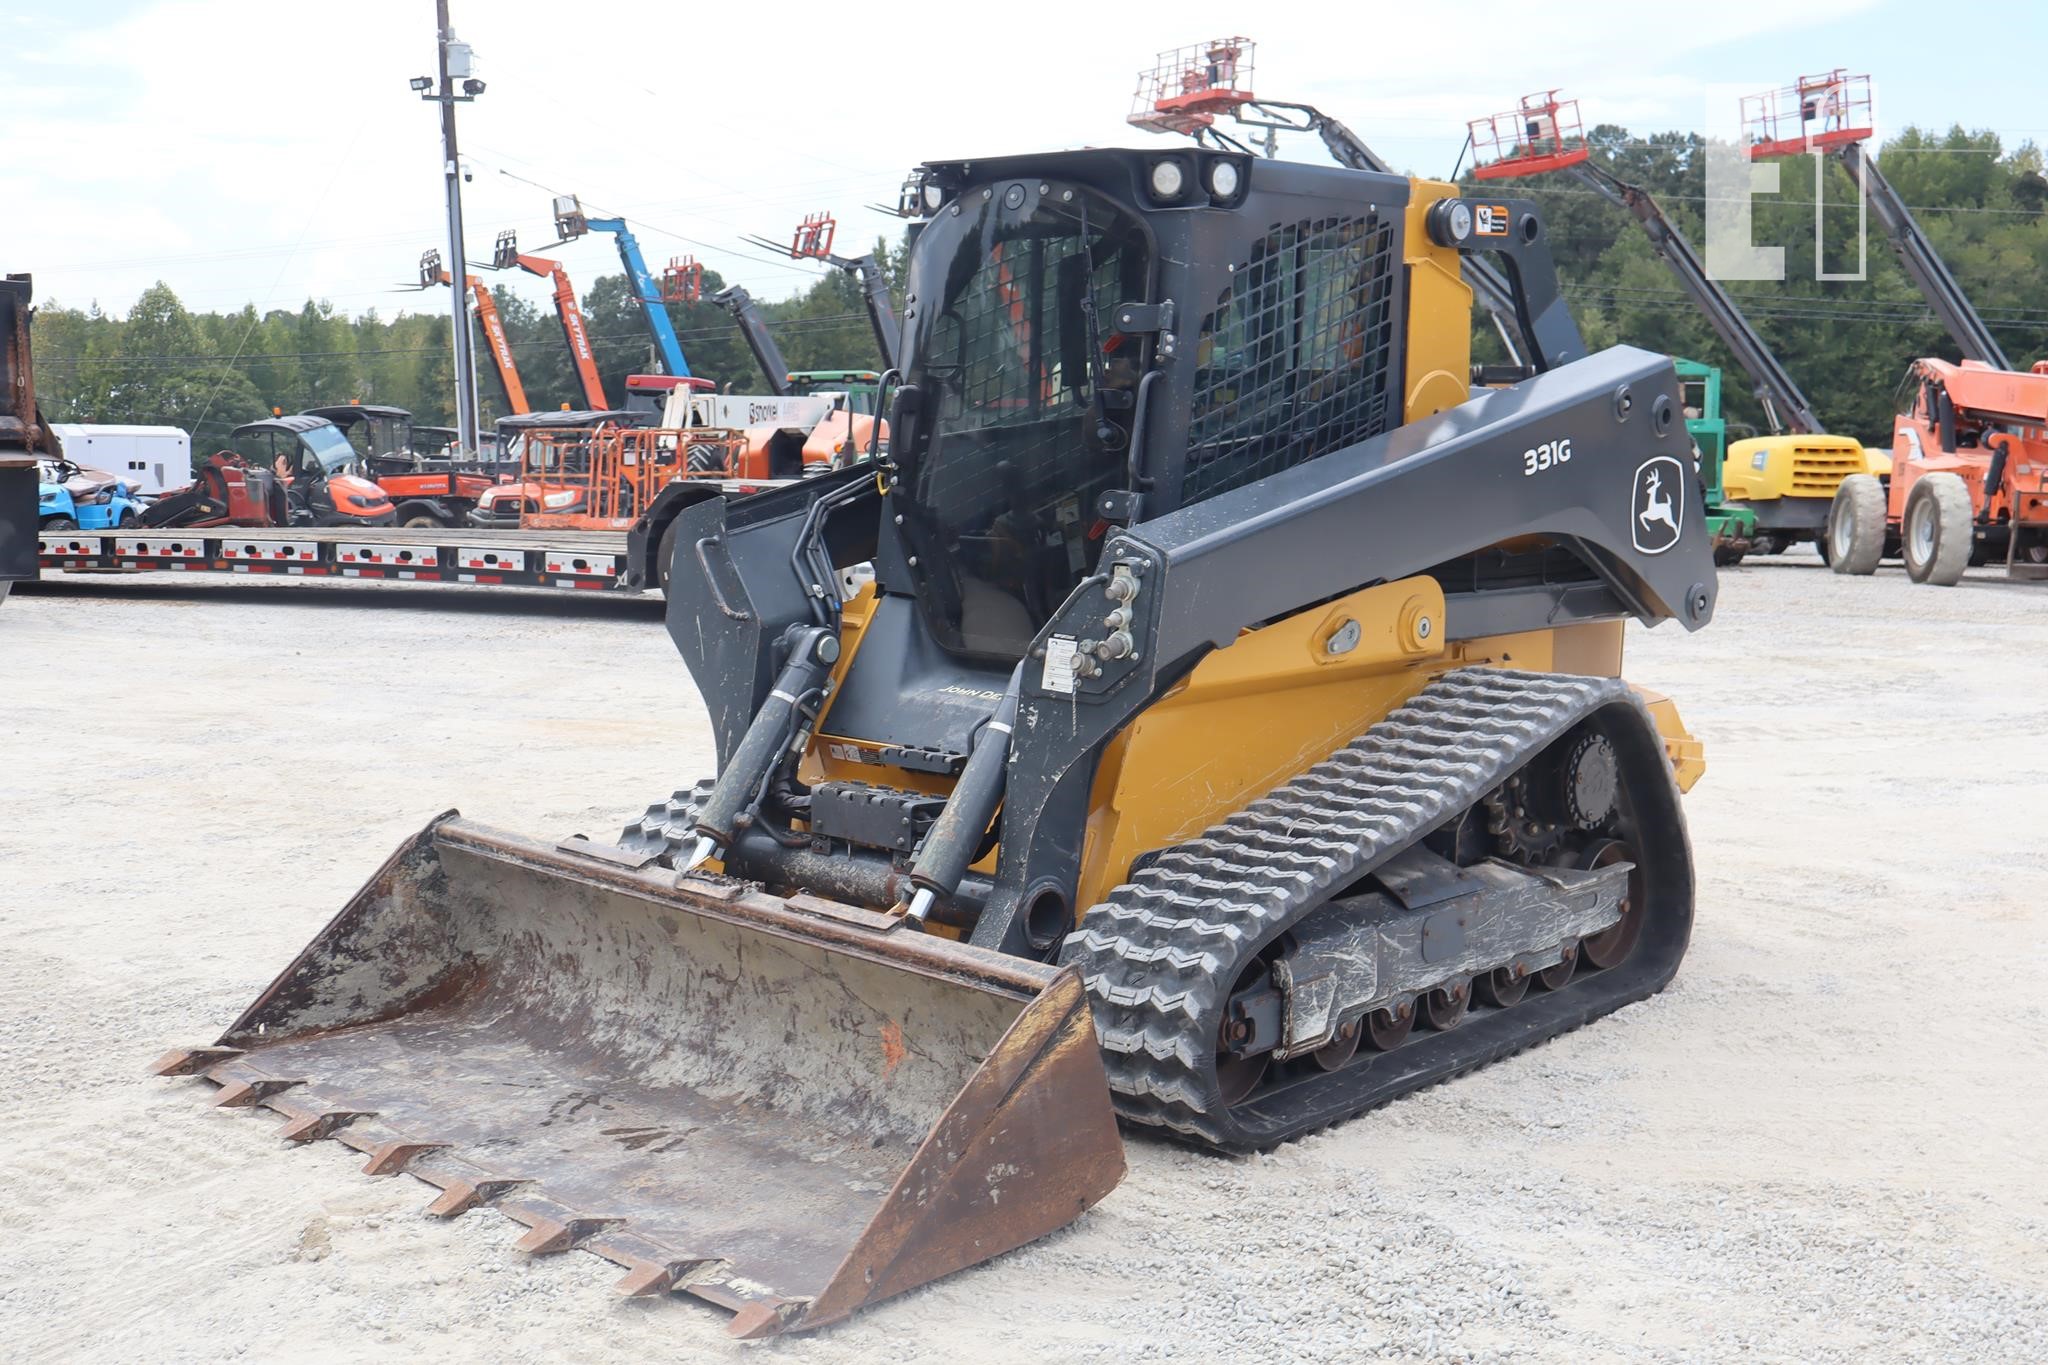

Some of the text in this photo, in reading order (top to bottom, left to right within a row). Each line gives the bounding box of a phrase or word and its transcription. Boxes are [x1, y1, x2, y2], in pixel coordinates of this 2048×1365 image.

[490, 324, 513, 369] SKYTRAK
[569, 313, 590, 360] SKYTRAK
[1523, 438, 1572, 476] 331G
[938, 685, 980, 697] JOHN
